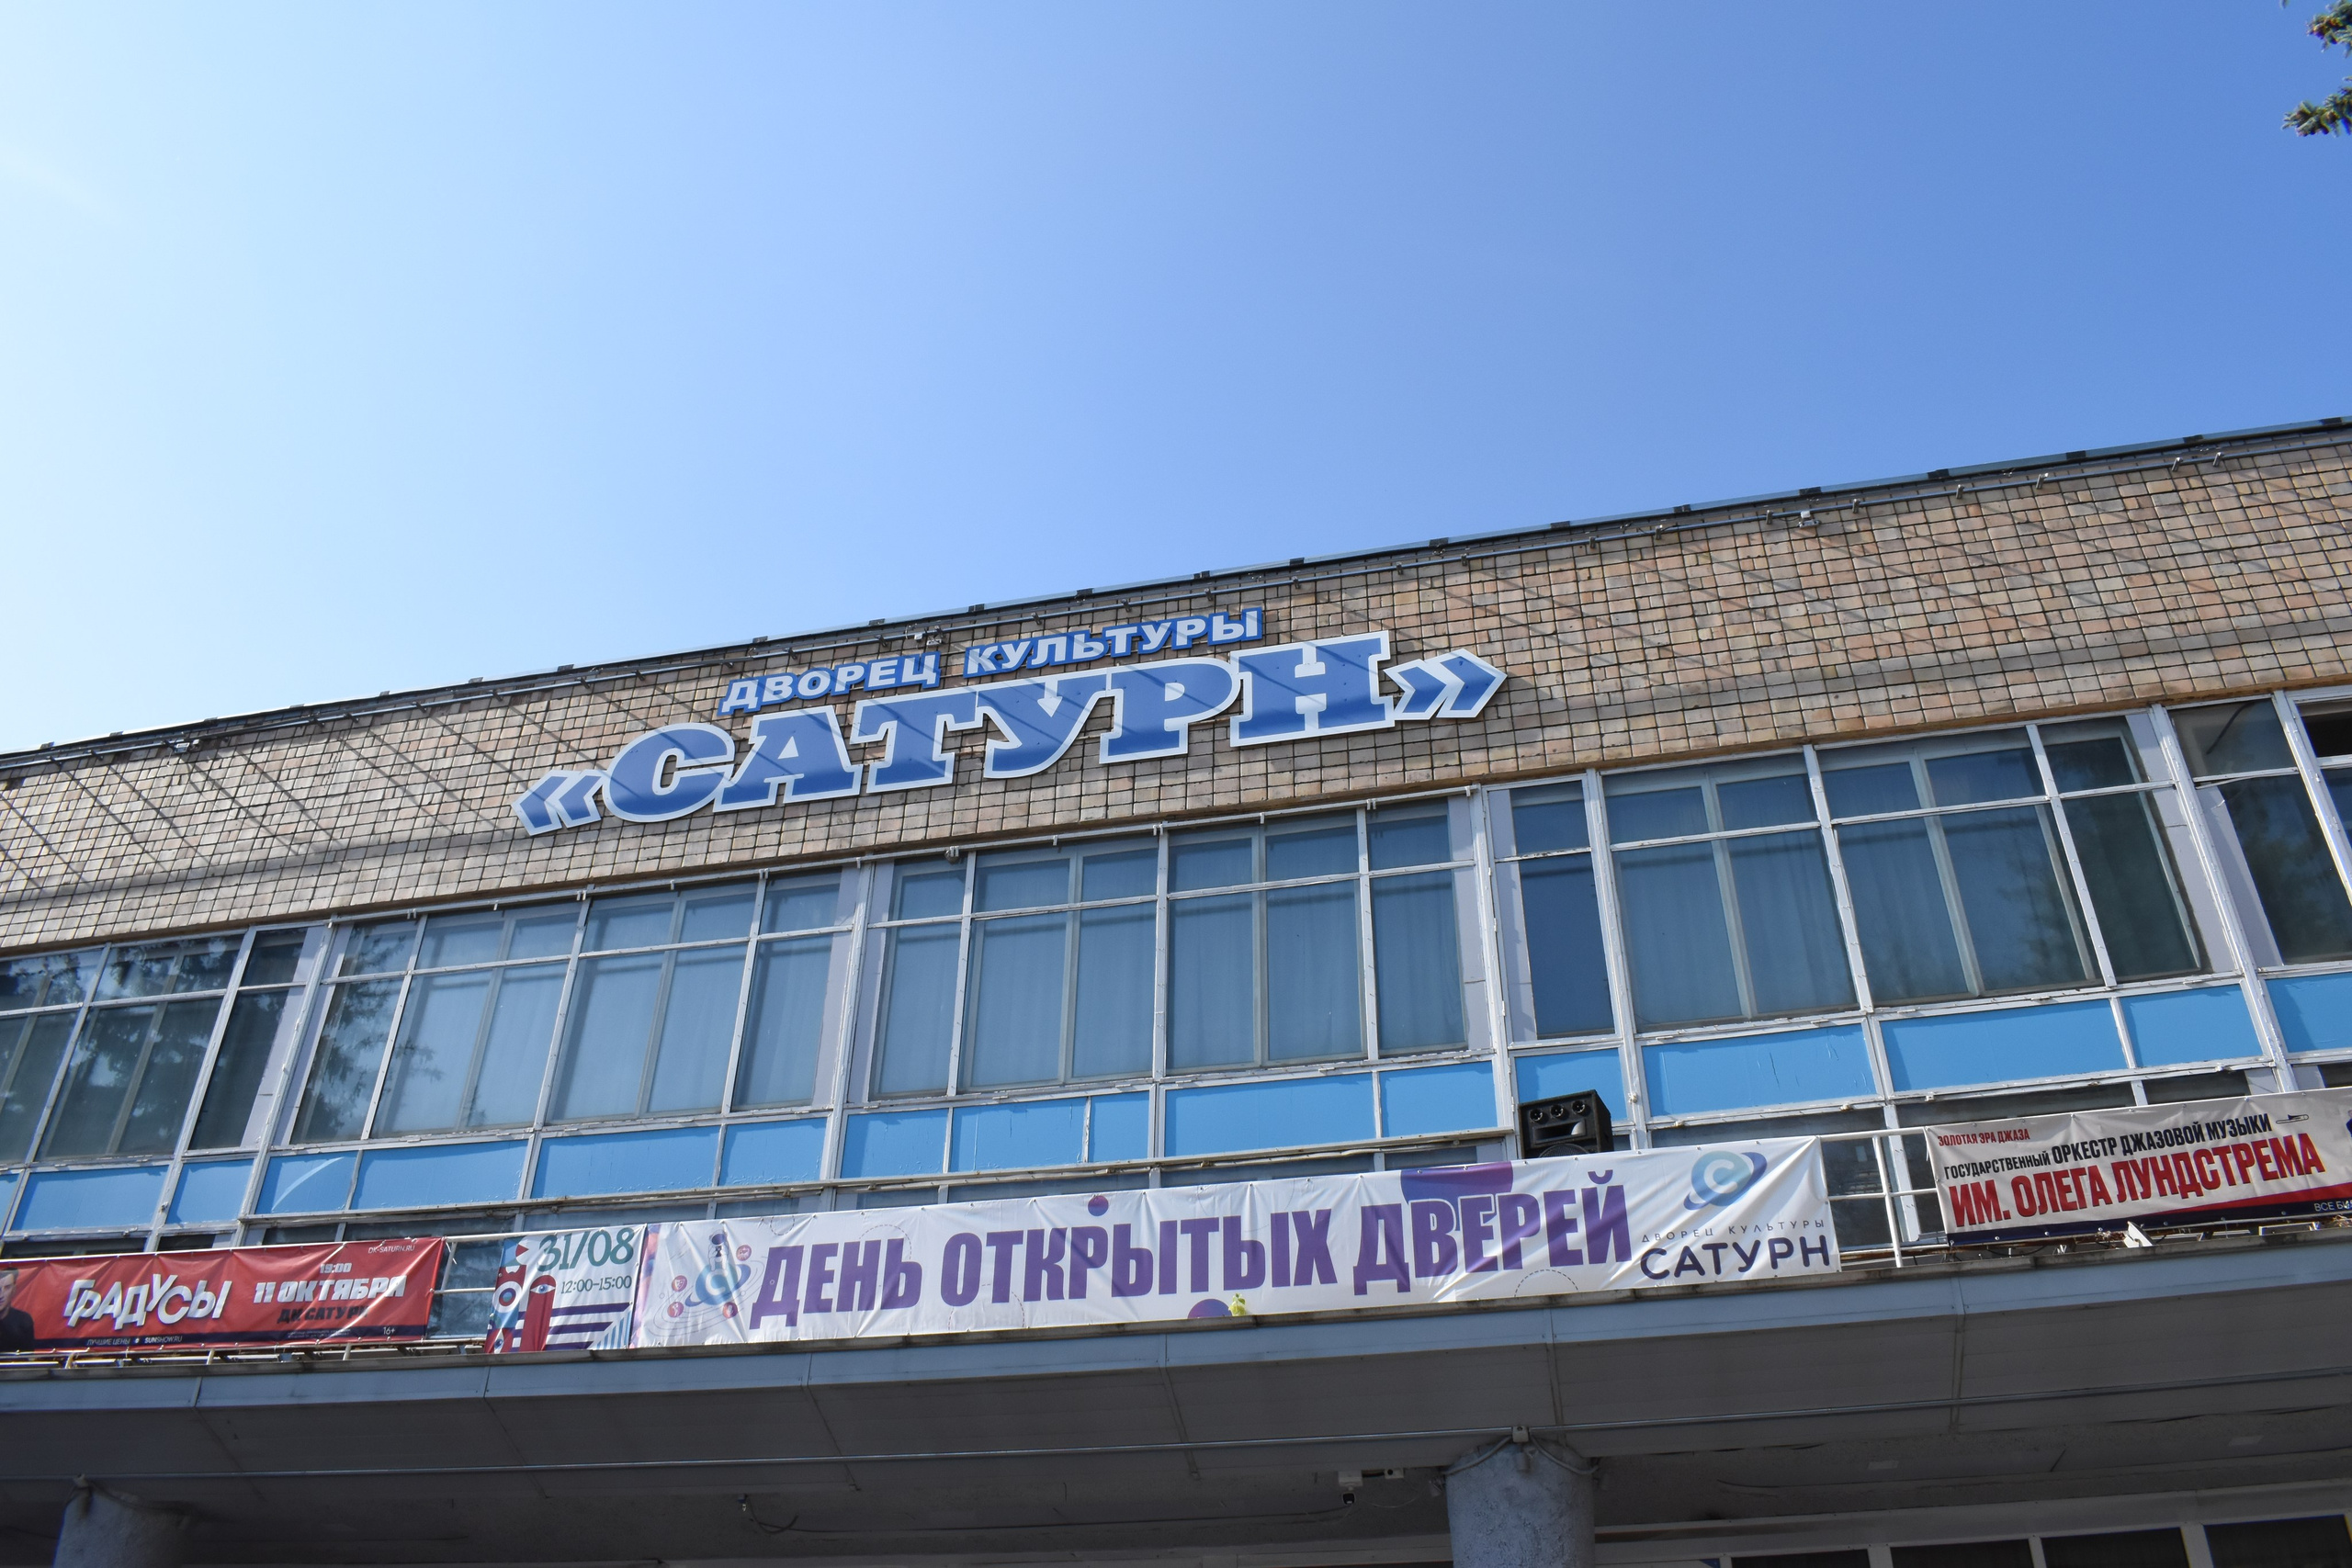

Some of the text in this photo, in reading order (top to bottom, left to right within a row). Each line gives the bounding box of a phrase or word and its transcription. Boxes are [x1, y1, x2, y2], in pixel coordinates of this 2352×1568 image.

[718, 607, 1263, 716] ДВОРЕЦ КУЛЬТУРЫ
[1938, 1128, 2030, 1146] ЗОЛОТАЯ ЭРА ДЖАЗА
[1944, 1112, 2273, 1179] ГОСУДАРСТВЕННЫЙ ОРКЕСТР ДЖАЗОВОЙ МУЗЫКИ
[1949, 1133, 2326, 1228] ИМ. ОЛЕГА ЛУНДСТРЕМА
[2313, 1201, 2335, 1212] ВСЕ
[1641, 1218, 1825, 1243] ДВОРЕЦ КУЛЬТУРЫ
[368, 1245, 415, 1254] DK-SATURN.RU
[537, 1226, 635, 1272] 31/08
[749, 1169, 1634, 1330] ДЕНЬ ОТКРЫТЫХ ДВЕРЕЙ
[1640, 1235, 1830, 1280] САТУРН
[320, 1262, 352, 1274] 19:00
[63, 1273, 232, 1330] ГРАДУСЫ
[254, 1275, 407, 1303] 11 ОКТЯБРЯ
[277, 1304, 369, 1324] ДК САТУРН
[144, 1336, 183, 1344] SUNSHOW.RU
[382, 1326, 396, 1336] 16+
